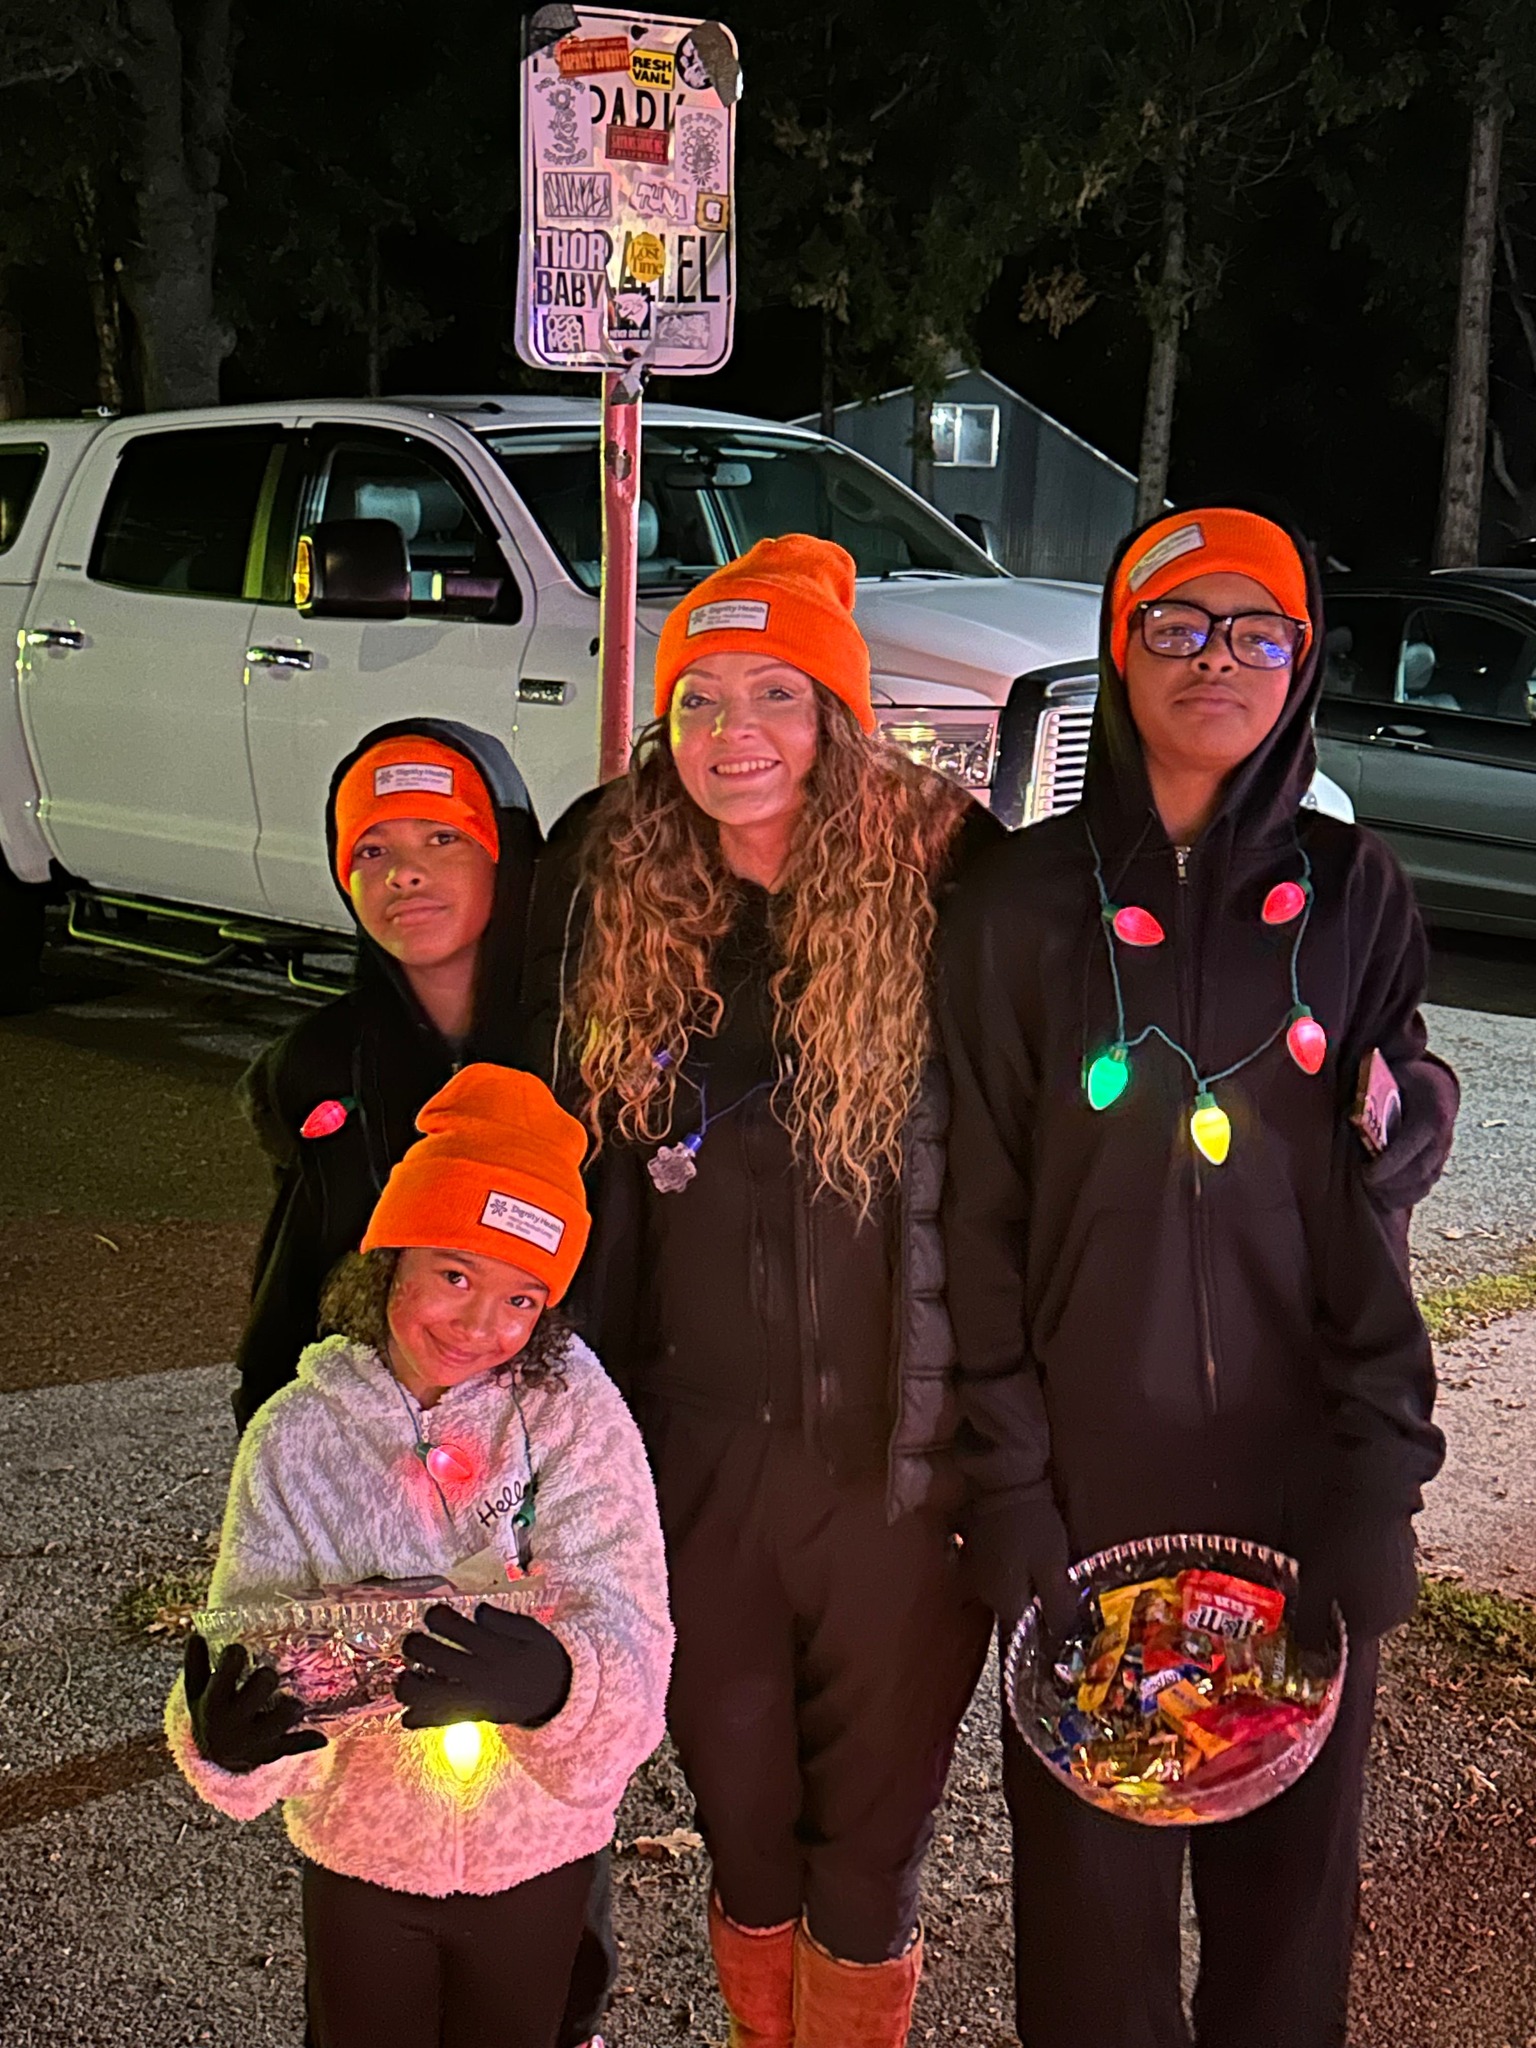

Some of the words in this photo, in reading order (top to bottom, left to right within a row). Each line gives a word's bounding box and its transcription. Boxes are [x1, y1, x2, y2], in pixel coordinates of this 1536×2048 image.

[632, 68, 670, 85] VANL
[633, 56, 672, 72] RESH
[536, 229, 605, 270] THOR
[537, 270, 605, 309] BABY
[510, 1204, 540, 1224] Dignity
[476, 1480, 526, 1528] Hell
